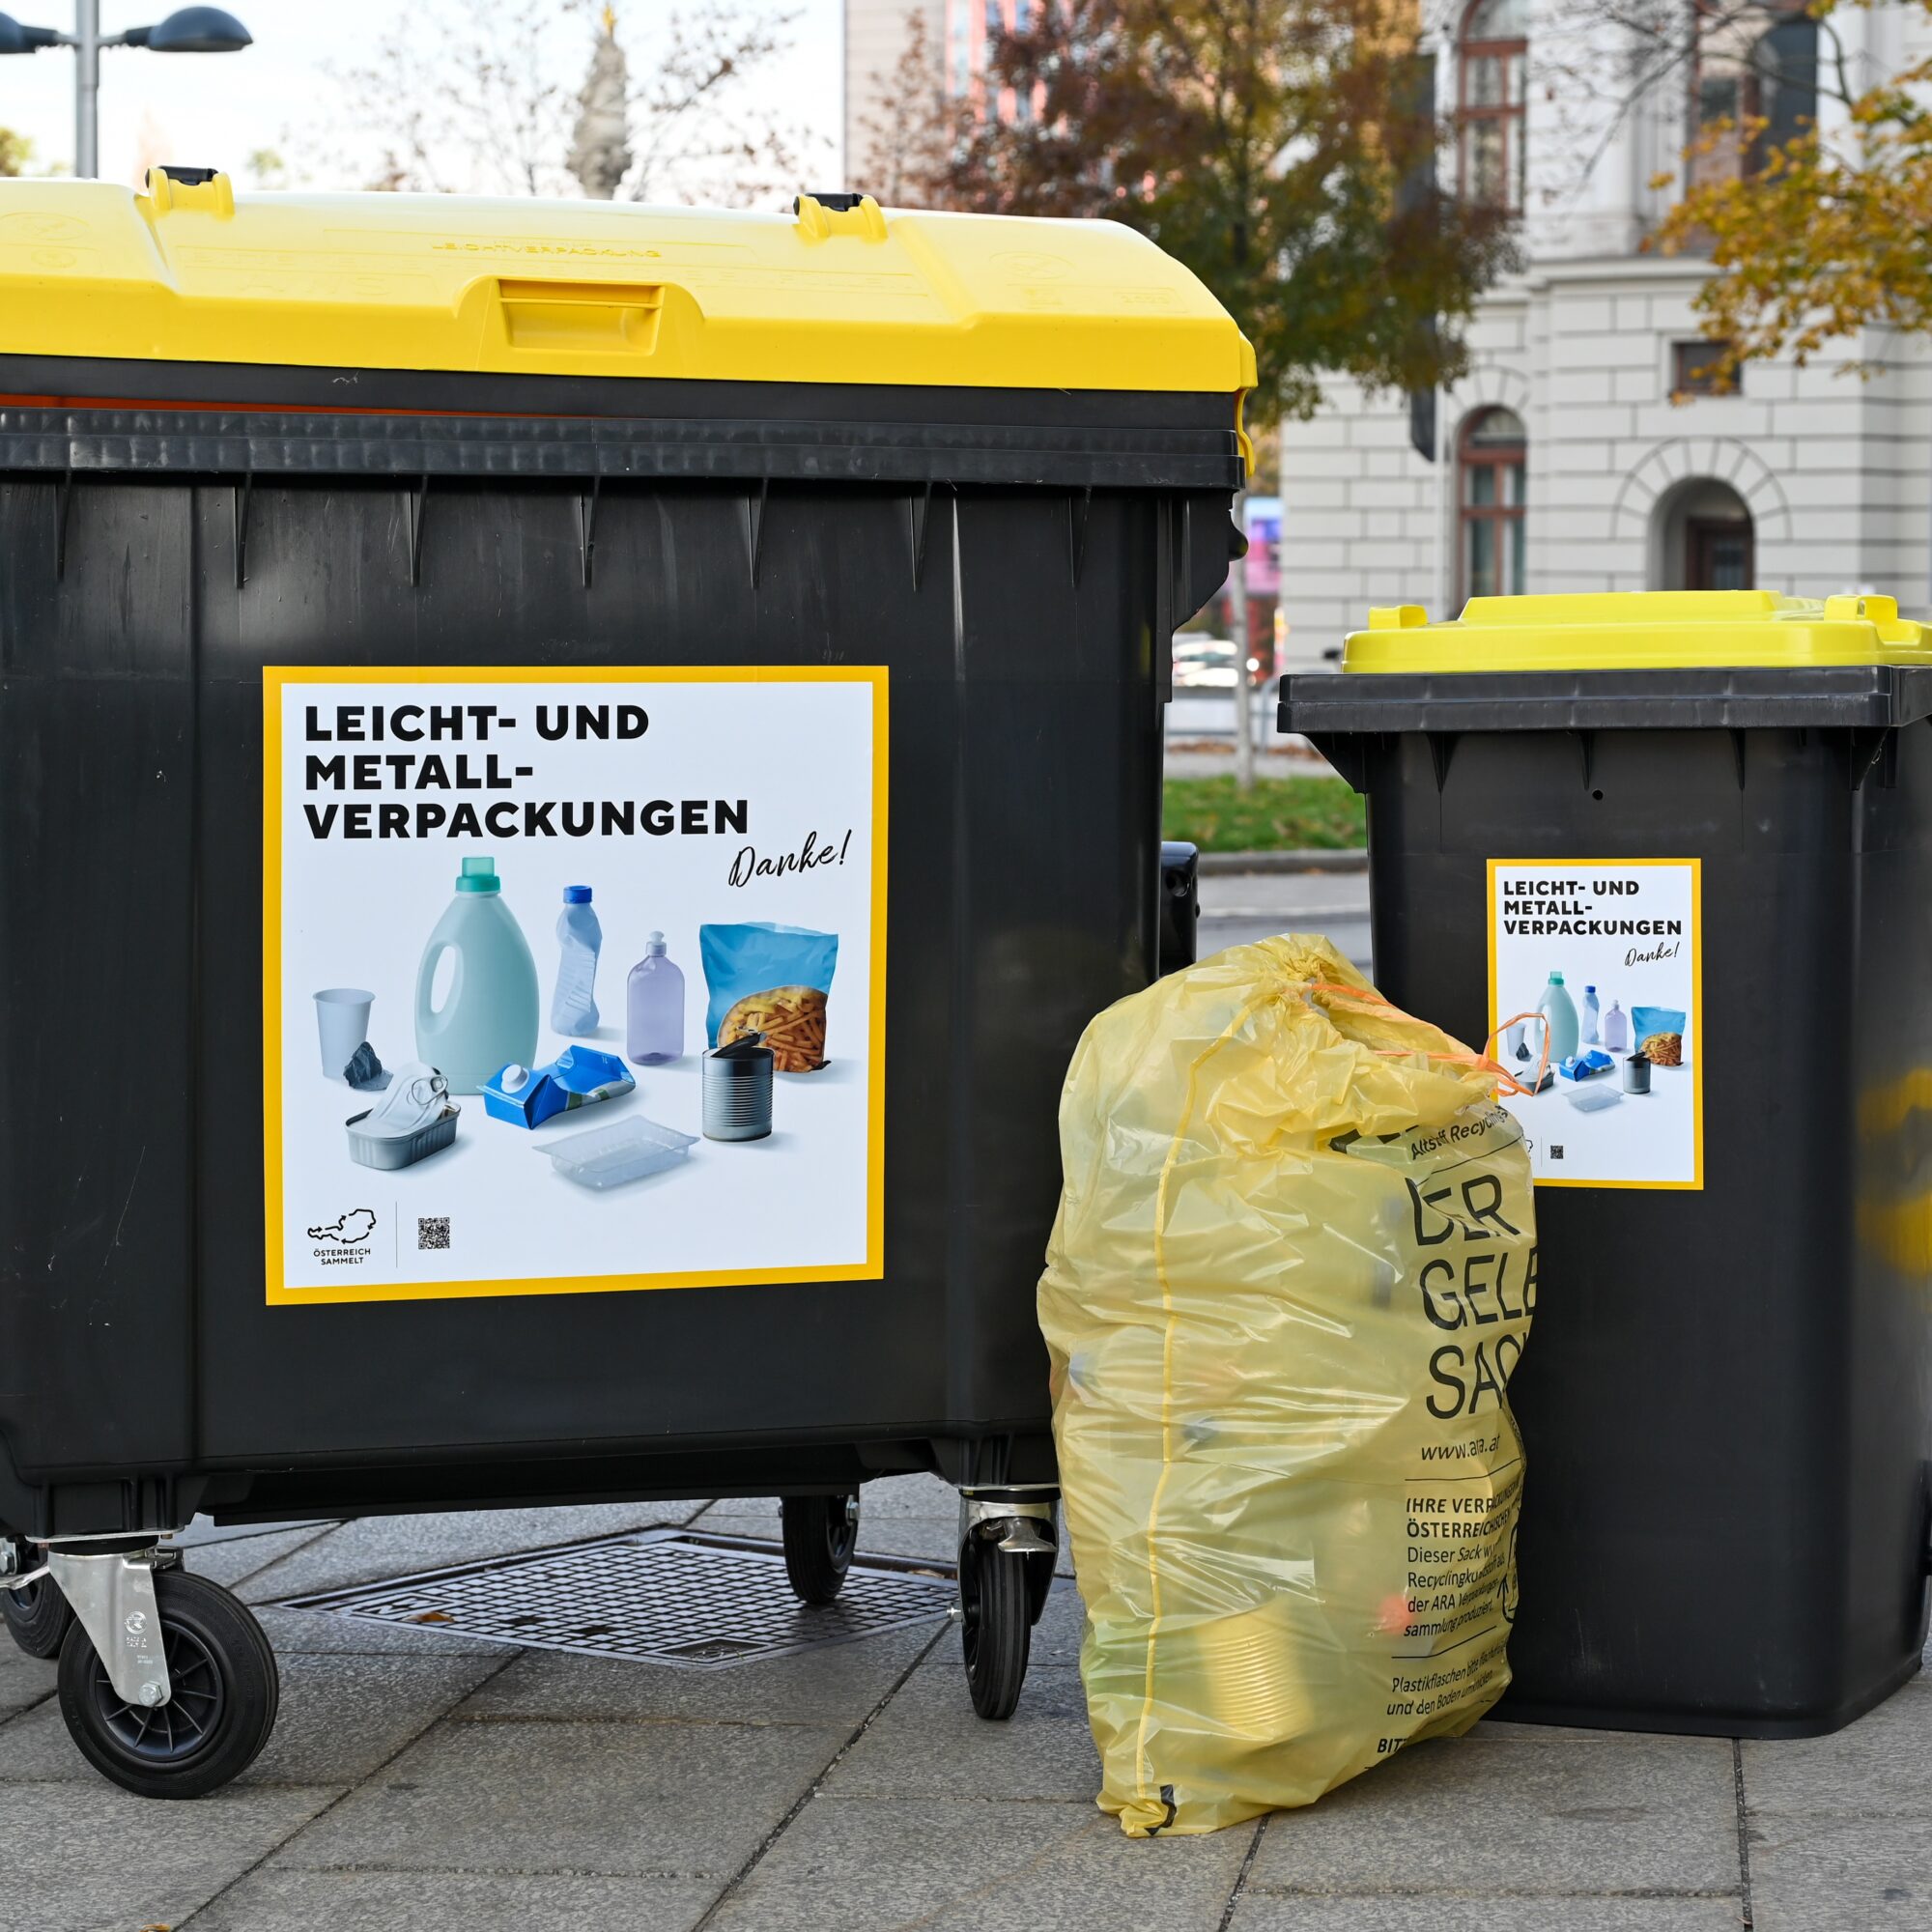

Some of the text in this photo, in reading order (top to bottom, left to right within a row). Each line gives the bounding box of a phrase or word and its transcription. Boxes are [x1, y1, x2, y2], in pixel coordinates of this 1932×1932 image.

[306, 705, 649, 742] LEICHT- UND
[306, 754, 533, 790] METALL-
[303, 800, 748, 839] VERPACKUNGEN
[728, 829, 852, 888] Danke!
[1503, 880, 1639, 895] LEICHT- UND
[1504, 901, 1593, 916] METALL-
[1503, 921, 1682, 935] VERPACKUNGEN
[1625, 941, 1680, 967] Danke!
[314, 1248, 371, 1258] ÖSTERREICH
[321, 1257, 364, 1265] SAMMELT
[1426, 1332, 1528, 1420] SAC
[1406, 1497, 1447, 1513] IHRE
[1407, 1547, 1455, 1563] Dieser
[1458, 1544, 1482, 1562] Sack
[1407, 1596, 1429, 1612] der
[1431, 1593, 1455, 1612] ARA
[1392, 1667, 1466, 1692] Plastikflaschen
[1386, 1700, 1414, 1716] und
[1415, 1698, 1435, 1715] den
[1436, 1689, 1461, 1710] Boden
[1377, 1738, 1407, 1754] BIT
